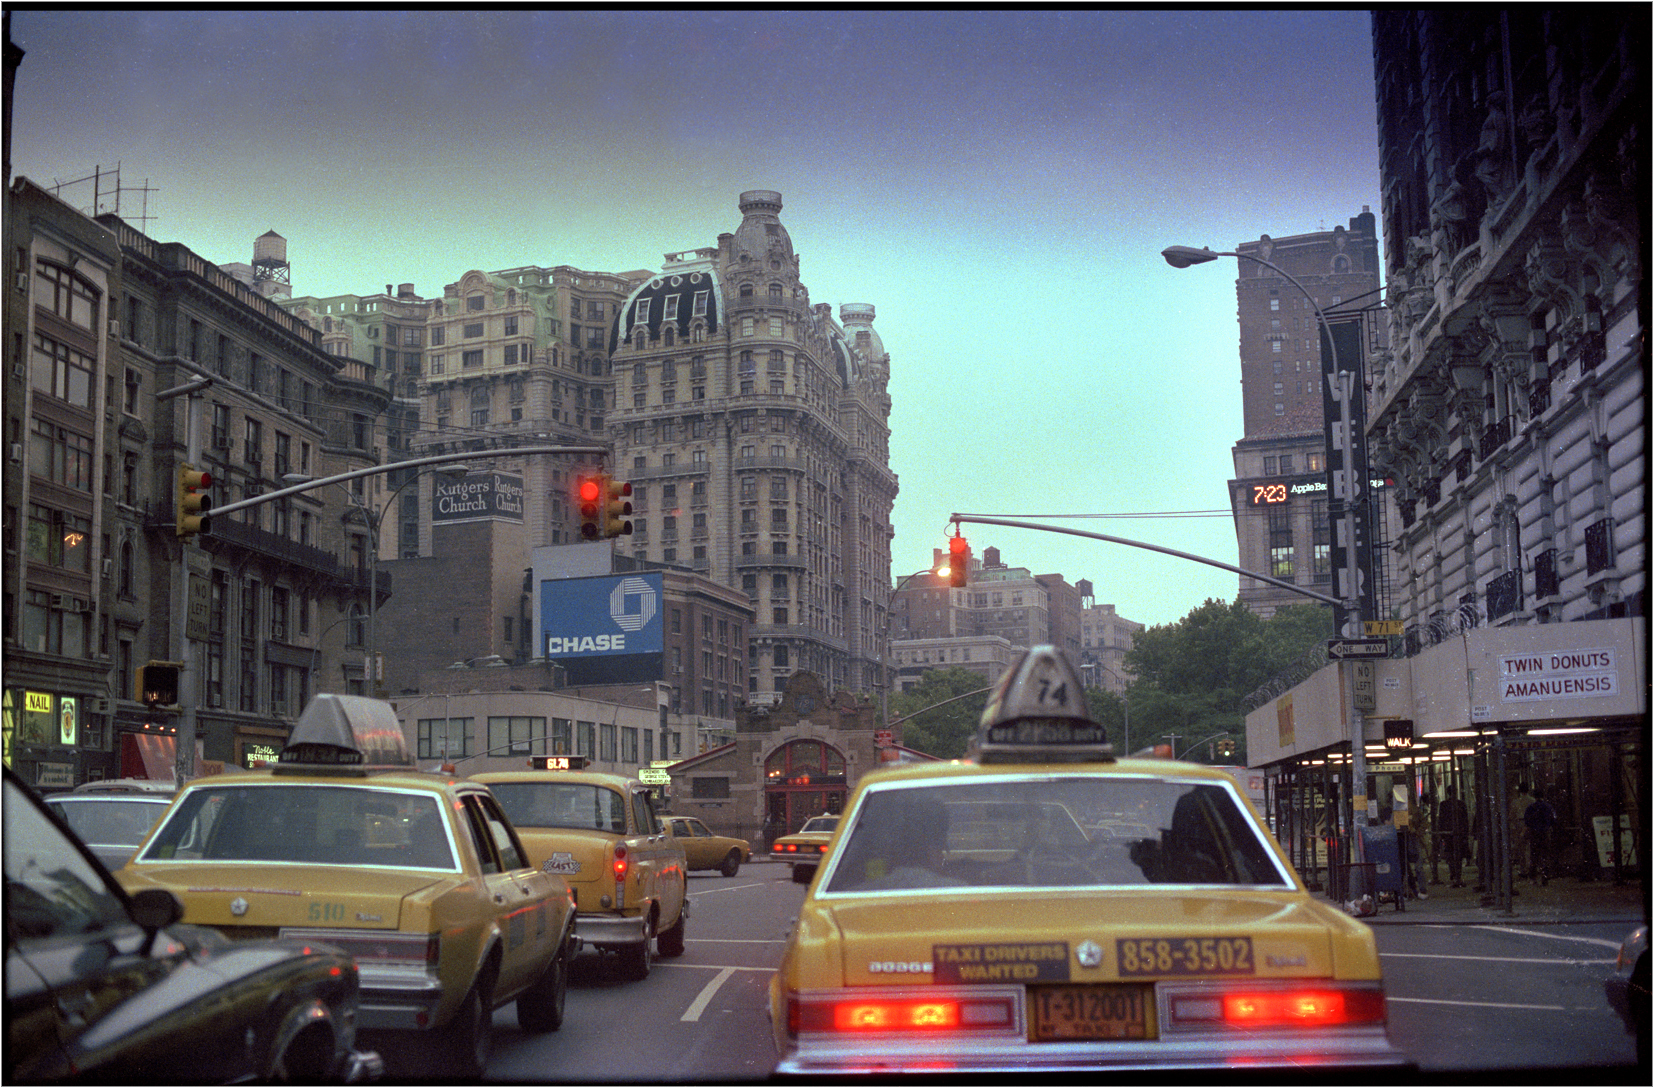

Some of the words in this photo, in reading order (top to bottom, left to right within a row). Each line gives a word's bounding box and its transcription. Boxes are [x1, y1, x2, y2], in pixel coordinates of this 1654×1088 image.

[436, 482, 489, 501] Rutgers
[494, 475, 523, 500] Rutgers
[1254, 485, 1286, 504] 7:23
[1290, 484, 1315, 495] Apple
[439, 494, 487, 514] Church
[496, 493, 522, 513] Church
[195, 583, 206, 599] NO
[191, 602, 207, 616] LEFT
[190, 619, 208, 634] TURN
[1365, 623, 1373, 633] W
[1378, 622, 1389, 633] 71
[549, 634, 625, 653] CHASE
[1336, 645, 1354, 653] ONE
[1365, 644, 1383, 653] WAY
[1505, 658, 1543, 673] TWIN
[1551, 653, 1610, 670] DONUTS
[1357, 666, 1369, 677] NO
[1356, 681, 1371, 691] LEFT
[1505, 677, 1611, 697] AMANUENSIS
[29, 694, 49, 711] NAIL
[1356, 694, 1372, 704] TURN
[1386, 738, 1411, 747] WALK
[247, 753, 279, 763] RESTAURANT
[551, 861, 573, 870] LAST
[308, 902, 345, 921] 510
[935, 947, 981, 962] TAXI
[984, 945, 1067, 961] DRIVERS
[1122, 939, 1251, 971] 858-3502
[869, 961, 934, 973] DODGE
[958, 963, 1038, 979] WANTED
